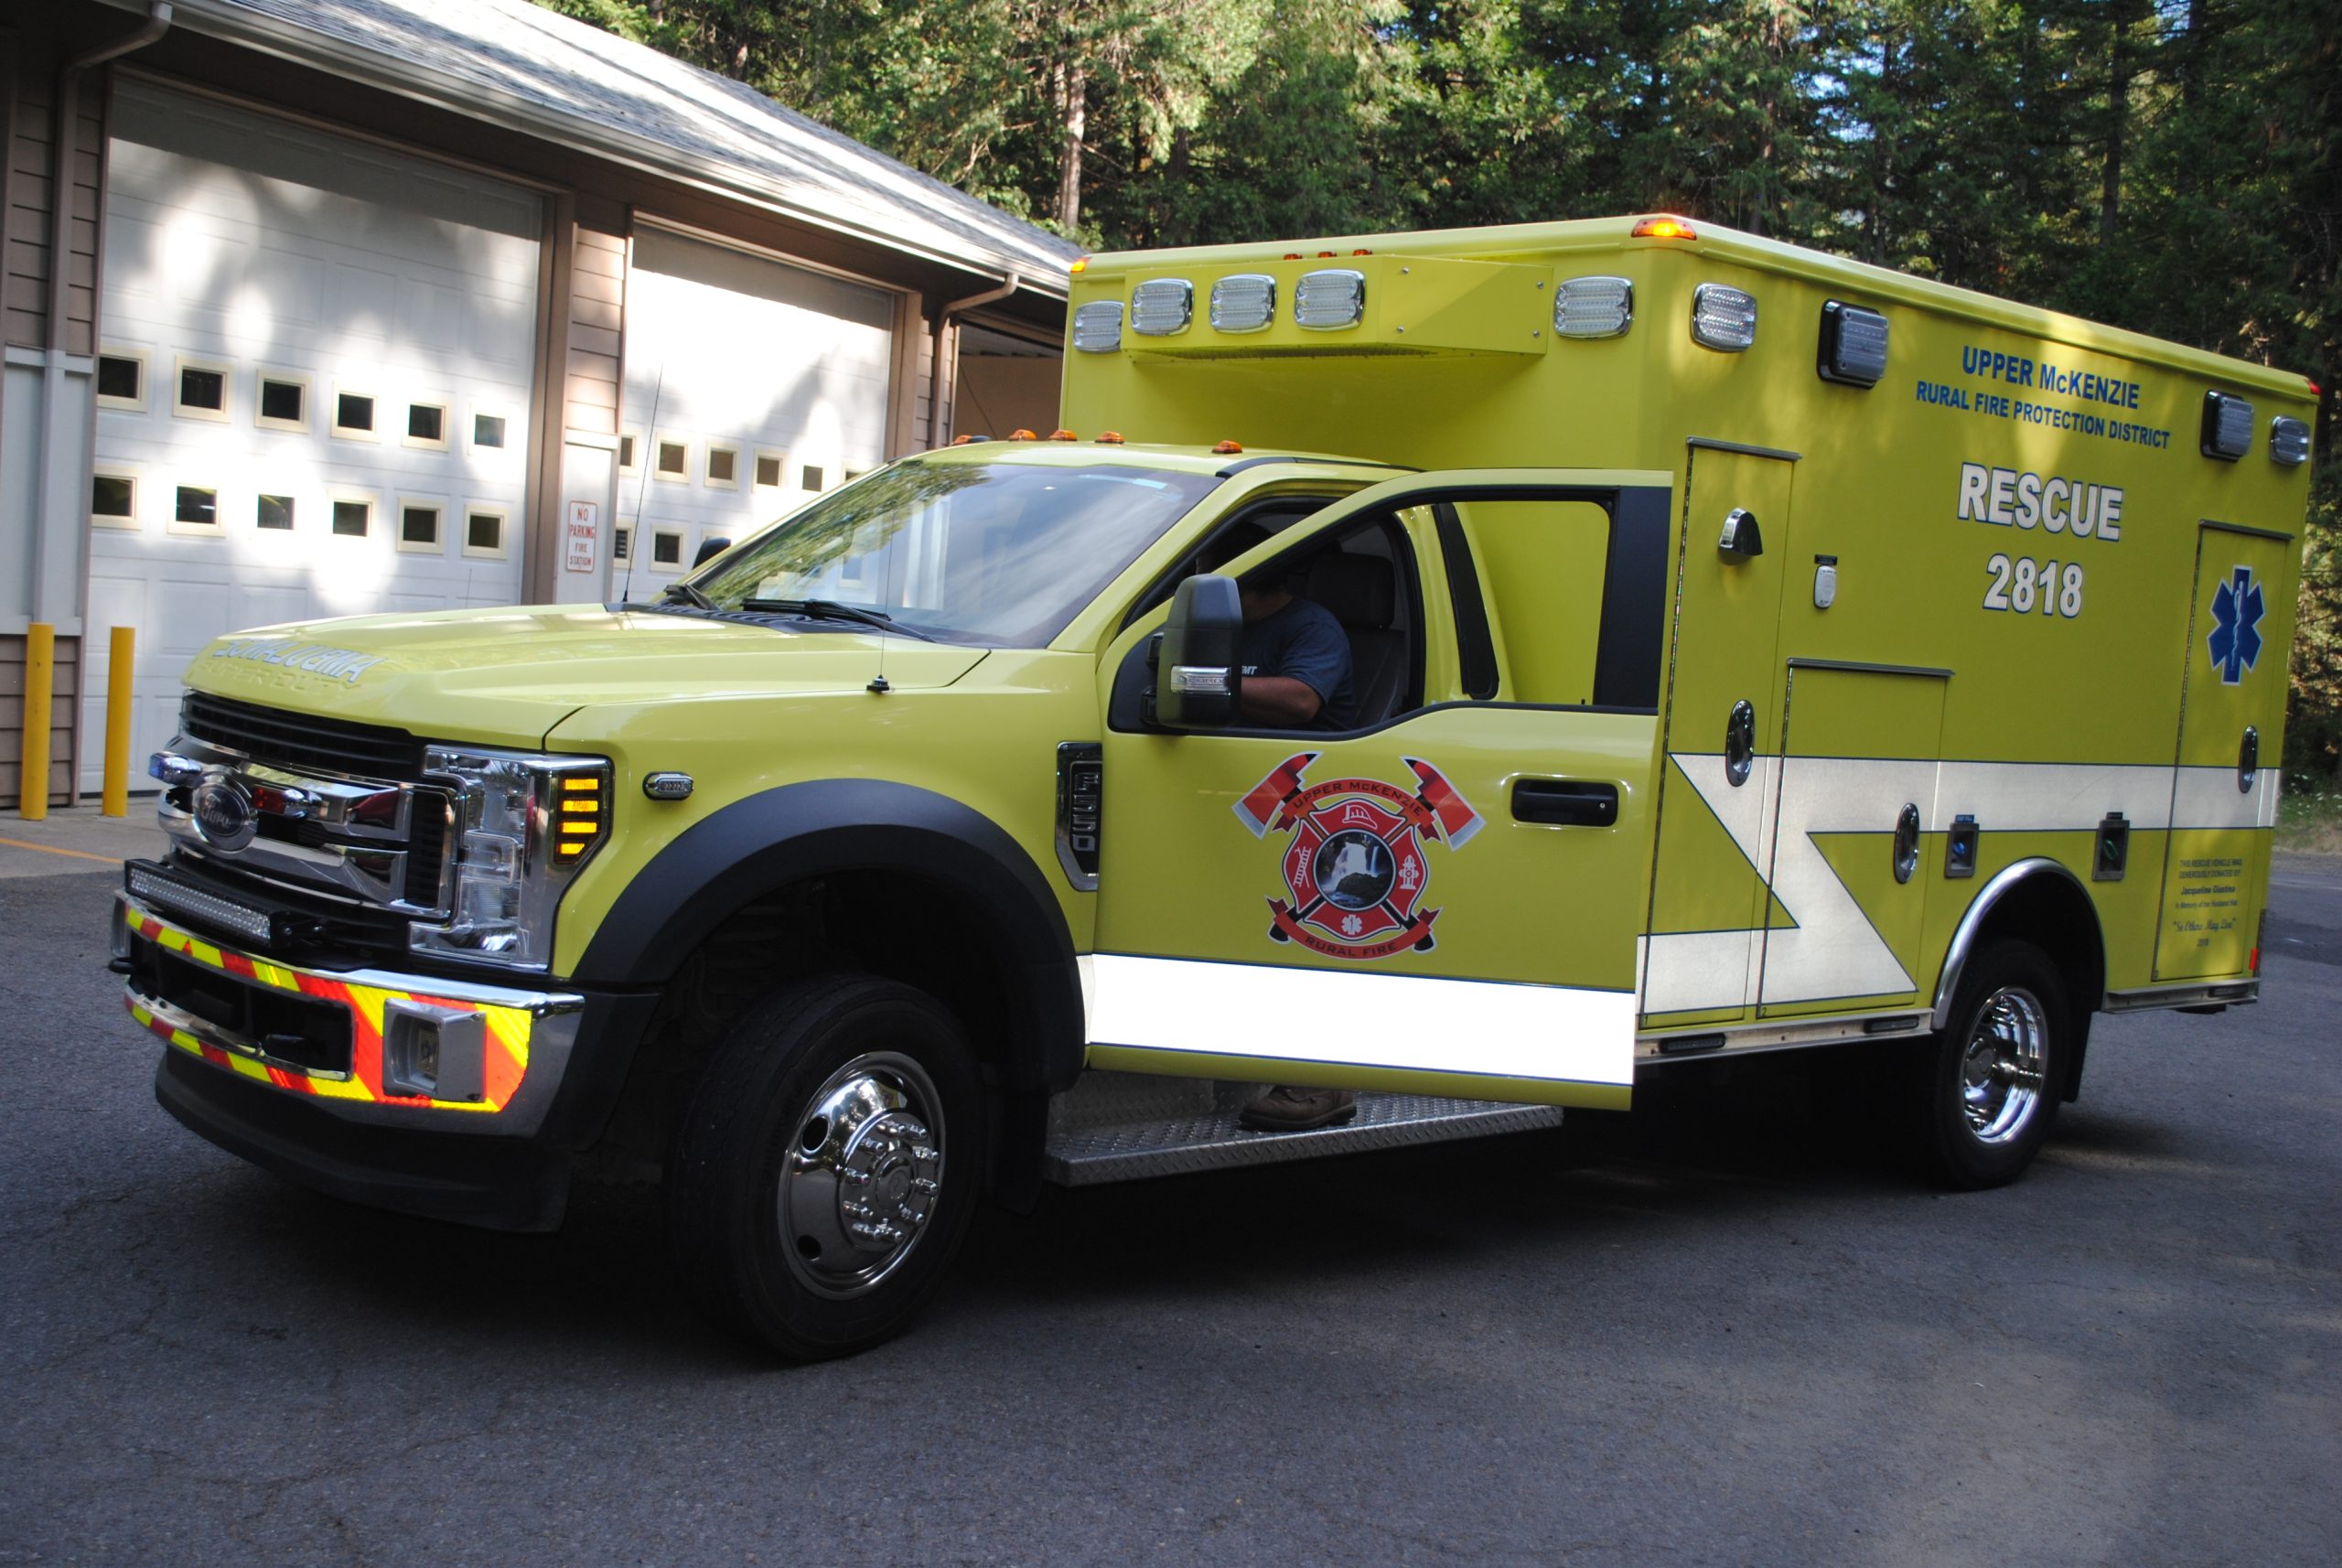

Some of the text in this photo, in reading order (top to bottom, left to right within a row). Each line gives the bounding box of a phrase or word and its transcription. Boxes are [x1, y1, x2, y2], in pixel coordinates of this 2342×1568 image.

[1962, 346, 2141, 410] UPPER McKENZIE
[1917, 381, 2170, 449] RURAL FIRE PROTECTION DISTRICT
[1957, 461, 2124, 542] RESCUE
[577, 508, 588, 521] NO
[569, 524, 596, 539] PARKING
[575, 542, 588, 553] FIRE
[569, 555, 592, 566] STATION
[1982, 553, 2084, 618] 2818
[1293, 781, 1424, 816] UPPER McKENZIE
[2191, 859, 2211, 867] RESCUE
[2212, 858, 2230, 867] VEHICLE
[1305, 935, 1398, 957] RURAL FIRE
